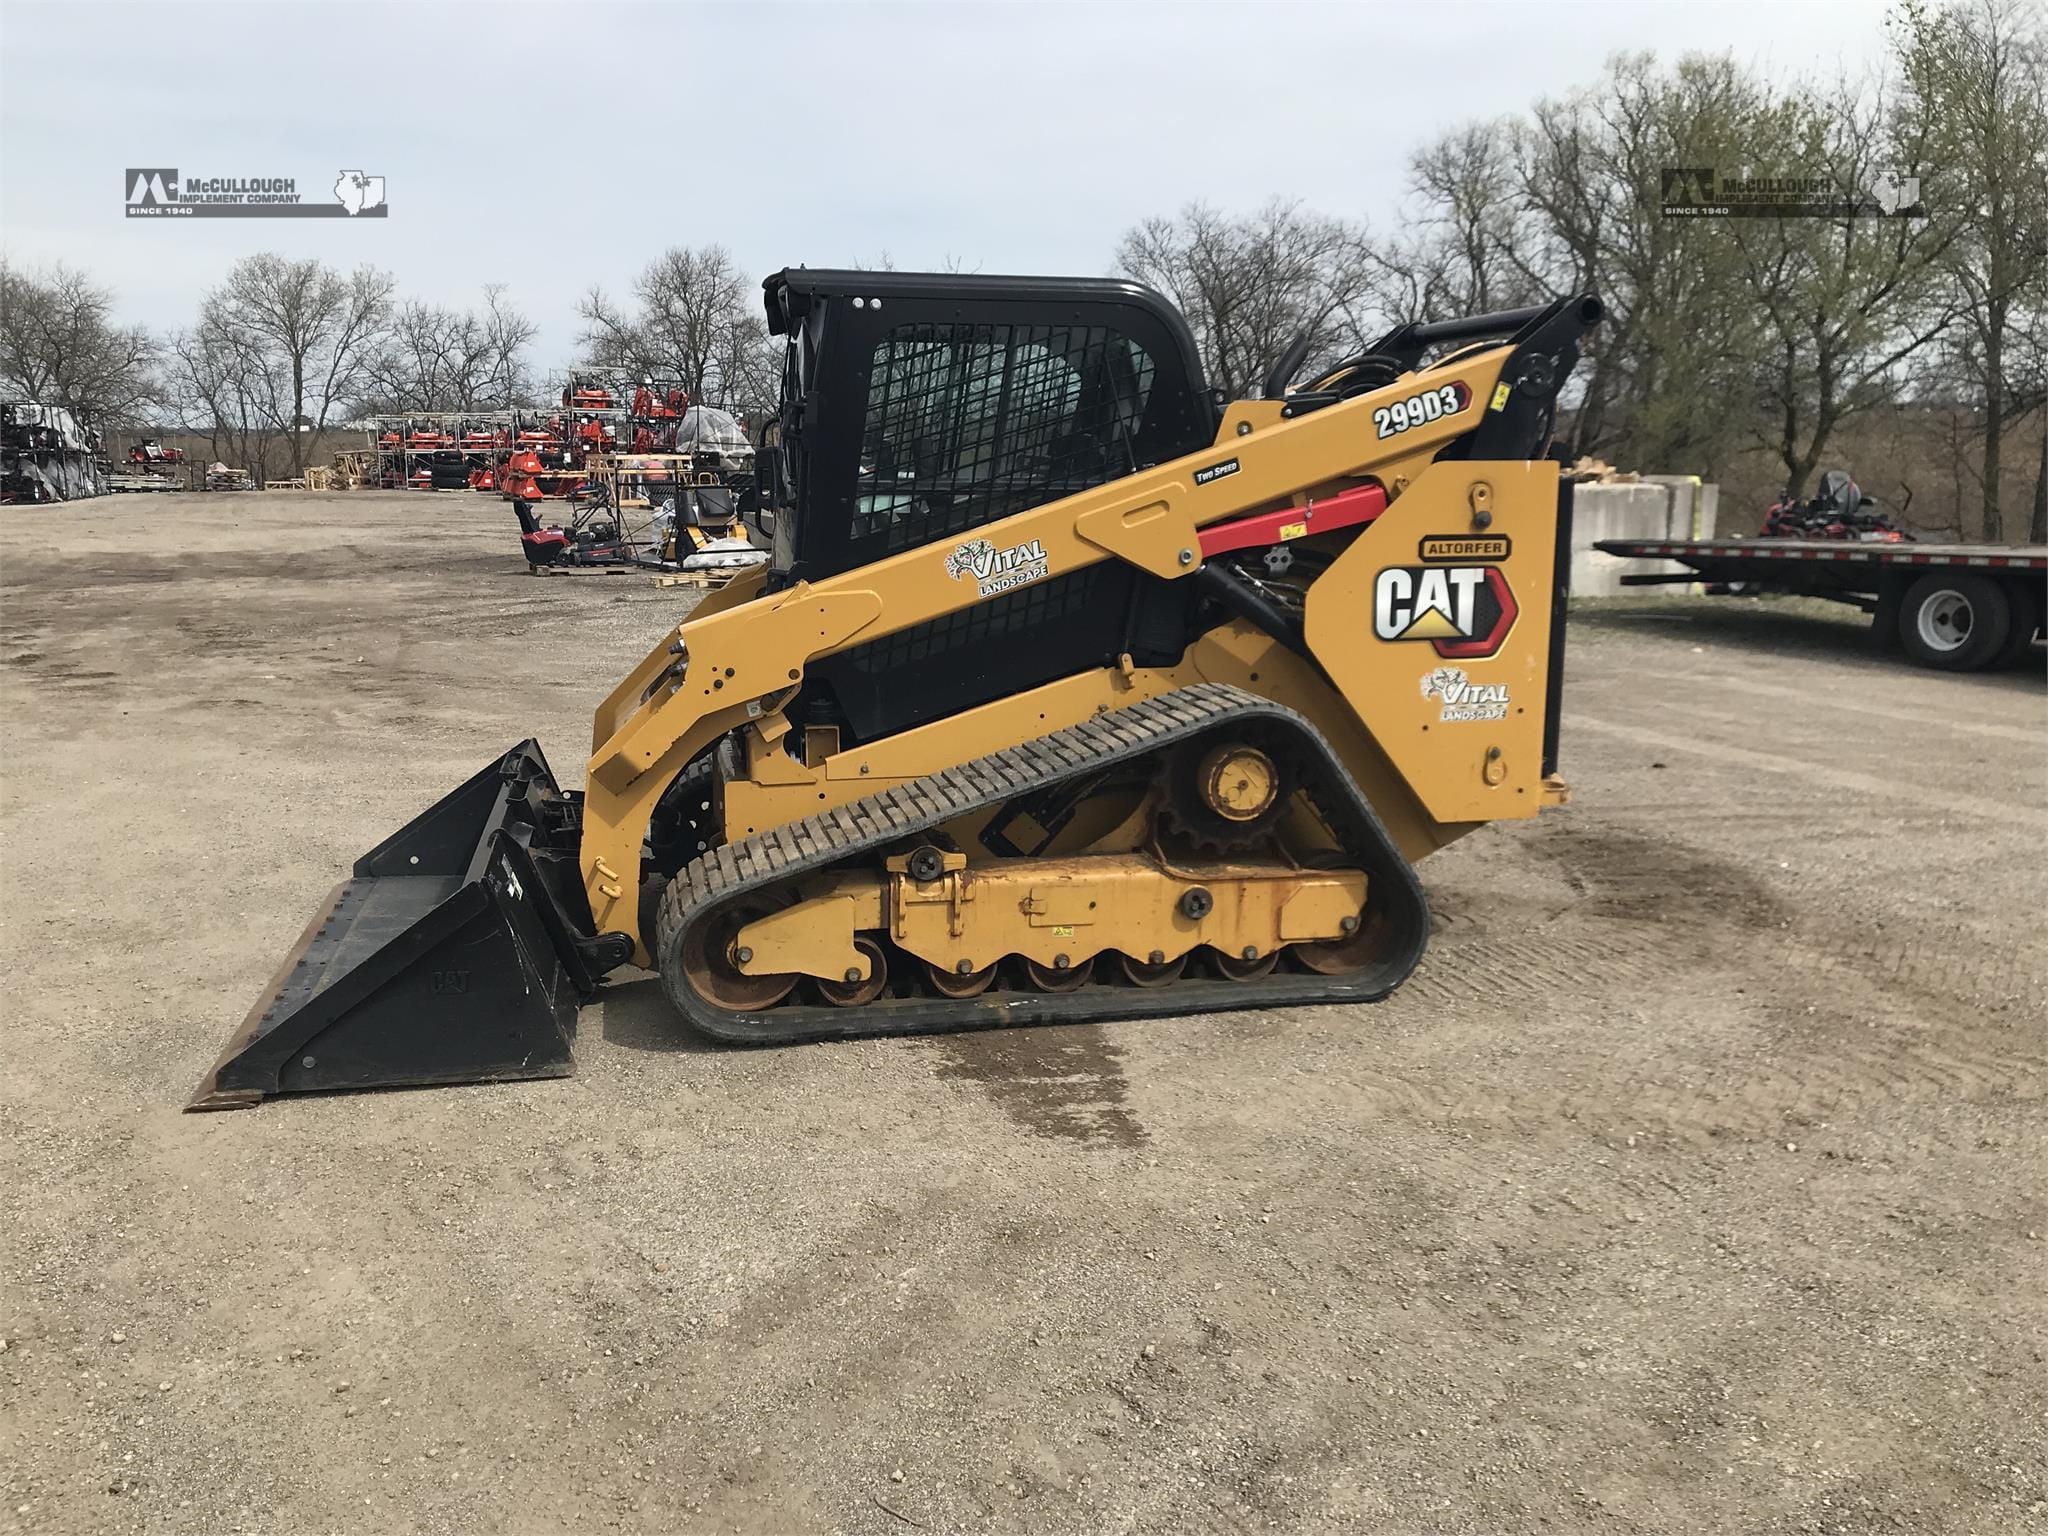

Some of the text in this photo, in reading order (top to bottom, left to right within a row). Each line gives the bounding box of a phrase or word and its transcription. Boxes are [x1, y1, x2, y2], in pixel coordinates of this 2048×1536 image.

[1373, 385, 1459, 440] 299D3
[972, 539, 1048, 580] VITAL
[1428, 542, 1502, 555] ALTORFER
[979, 565, 1049, 597] LANDSCAPE
[1376, 567, 1485, 639] CAT
[1443, 681, 1510, 704] VITAL
[1441, 709, 1507, 721] LANDSCAPE
[432, 970, 470, 994] CAT
